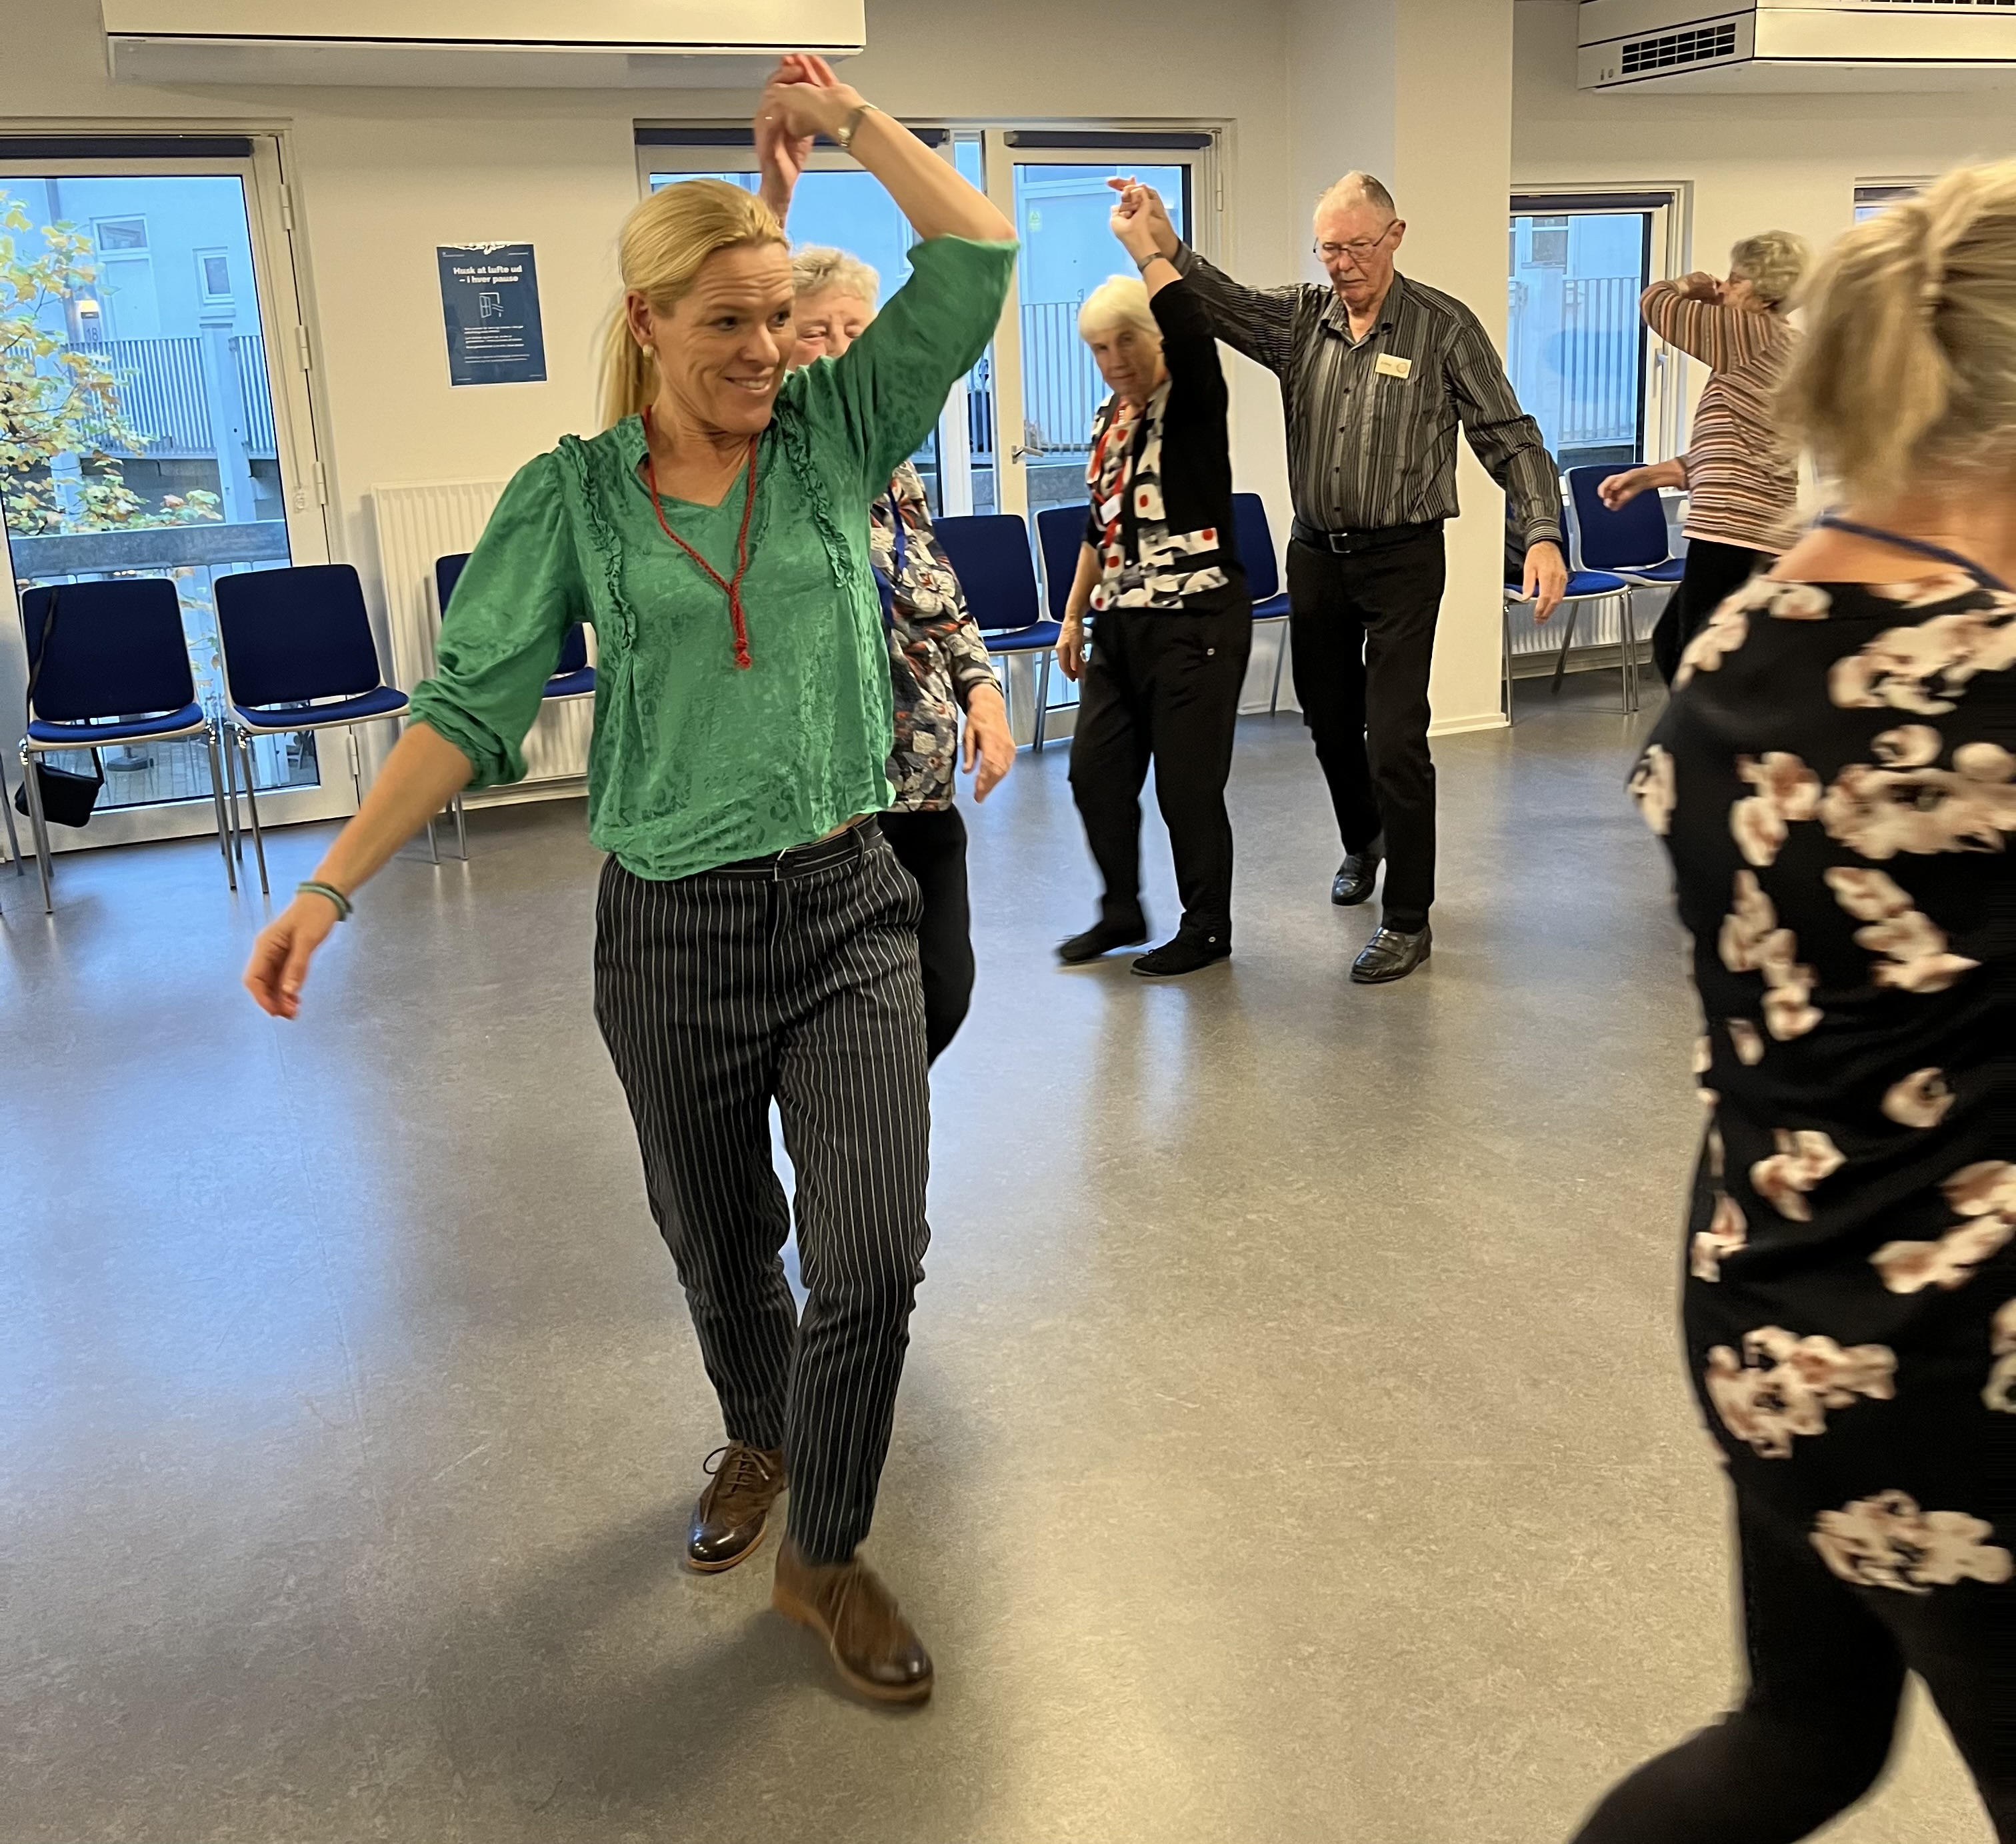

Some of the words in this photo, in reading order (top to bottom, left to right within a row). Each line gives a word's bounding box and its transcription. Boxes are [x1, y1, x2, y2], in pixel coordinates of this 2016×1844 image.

[453, 267, 476, 275] Husk
[477, 266, 487, 274] at
[487, 265, 509, 273] lufte
[511, 265, 523, 273] ud
[471, 275, 491, 283] hver
[493, 276, 519, 284] pause
[87, 327, 98, 342] 18
